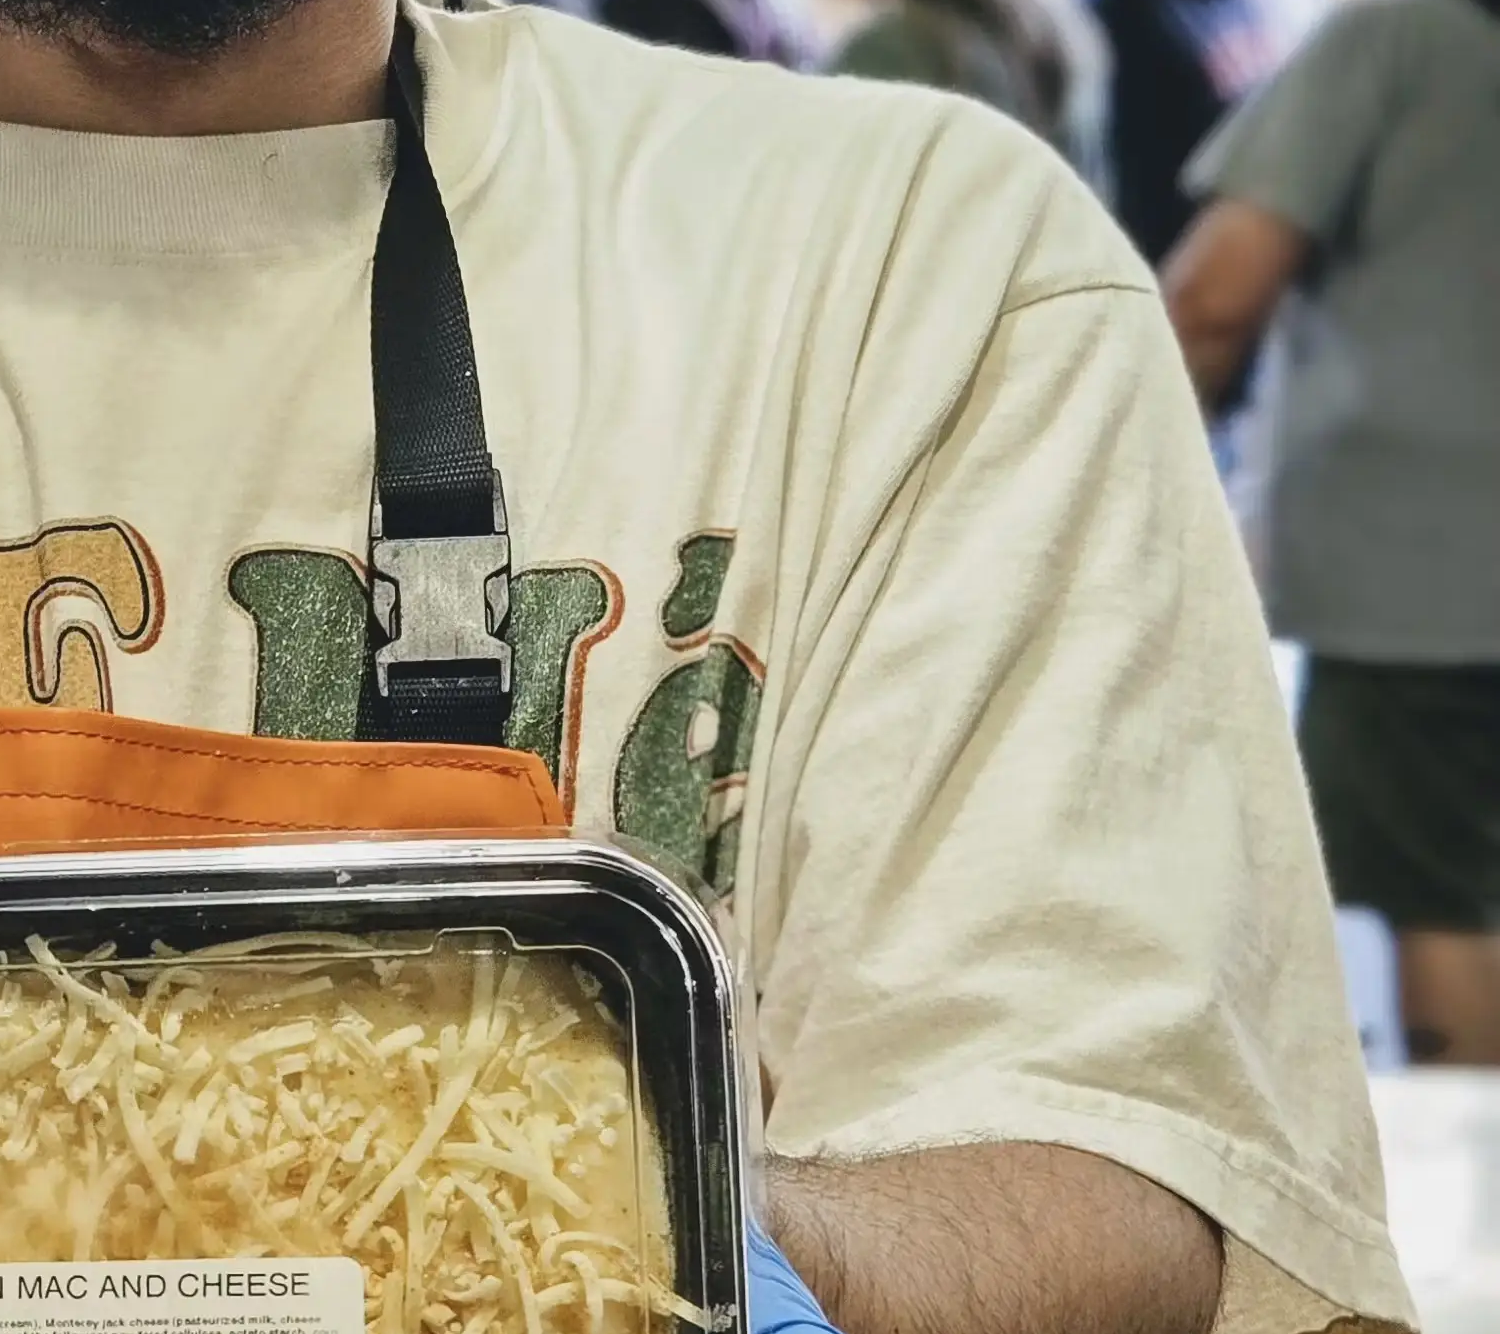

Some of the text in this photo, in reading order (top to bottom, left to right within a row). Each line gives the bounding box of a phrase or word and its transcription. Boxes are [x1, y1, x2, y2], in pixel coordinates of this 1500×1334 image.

[16, 1275, 88, 1300] MAC
[98, 1275, 166, 1299] AND
[175, 1272, 310, 1298] CHEESE
[46, 1318, 100, 1330] Monterey
[102, 1318, 126, 1329] jack
[129, 1318, 170, 1326] cheese
